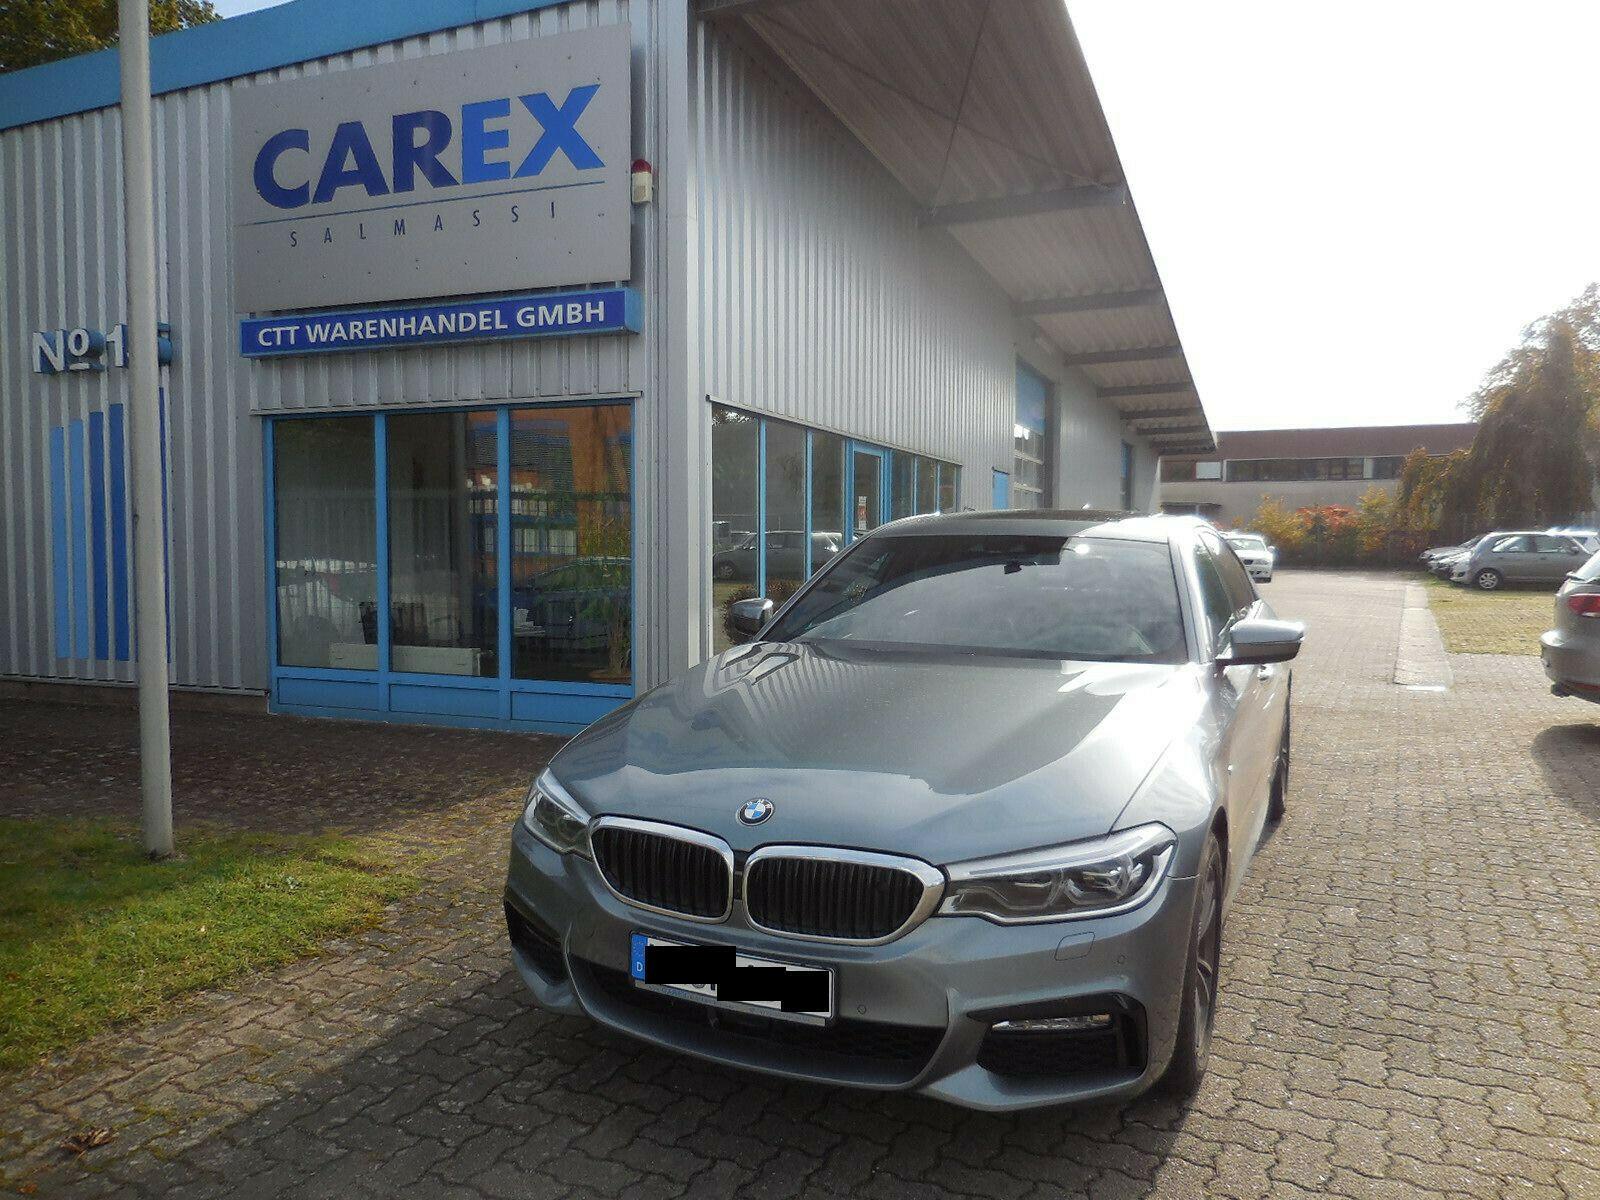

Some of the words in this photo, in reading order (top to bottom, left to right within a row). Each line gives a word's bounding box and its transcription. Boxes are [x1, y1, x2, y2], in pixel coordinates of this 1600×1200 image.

[253, 83, 606, 209] CAREX
[290, 201, 556, 248] SALMASSI
[257, 325, 300, 347] CTT
[306, 309, 508, 343] WARENHANDEL
[516, 301, 605, 328] GMBH
[636, 961, 643, 972] D
